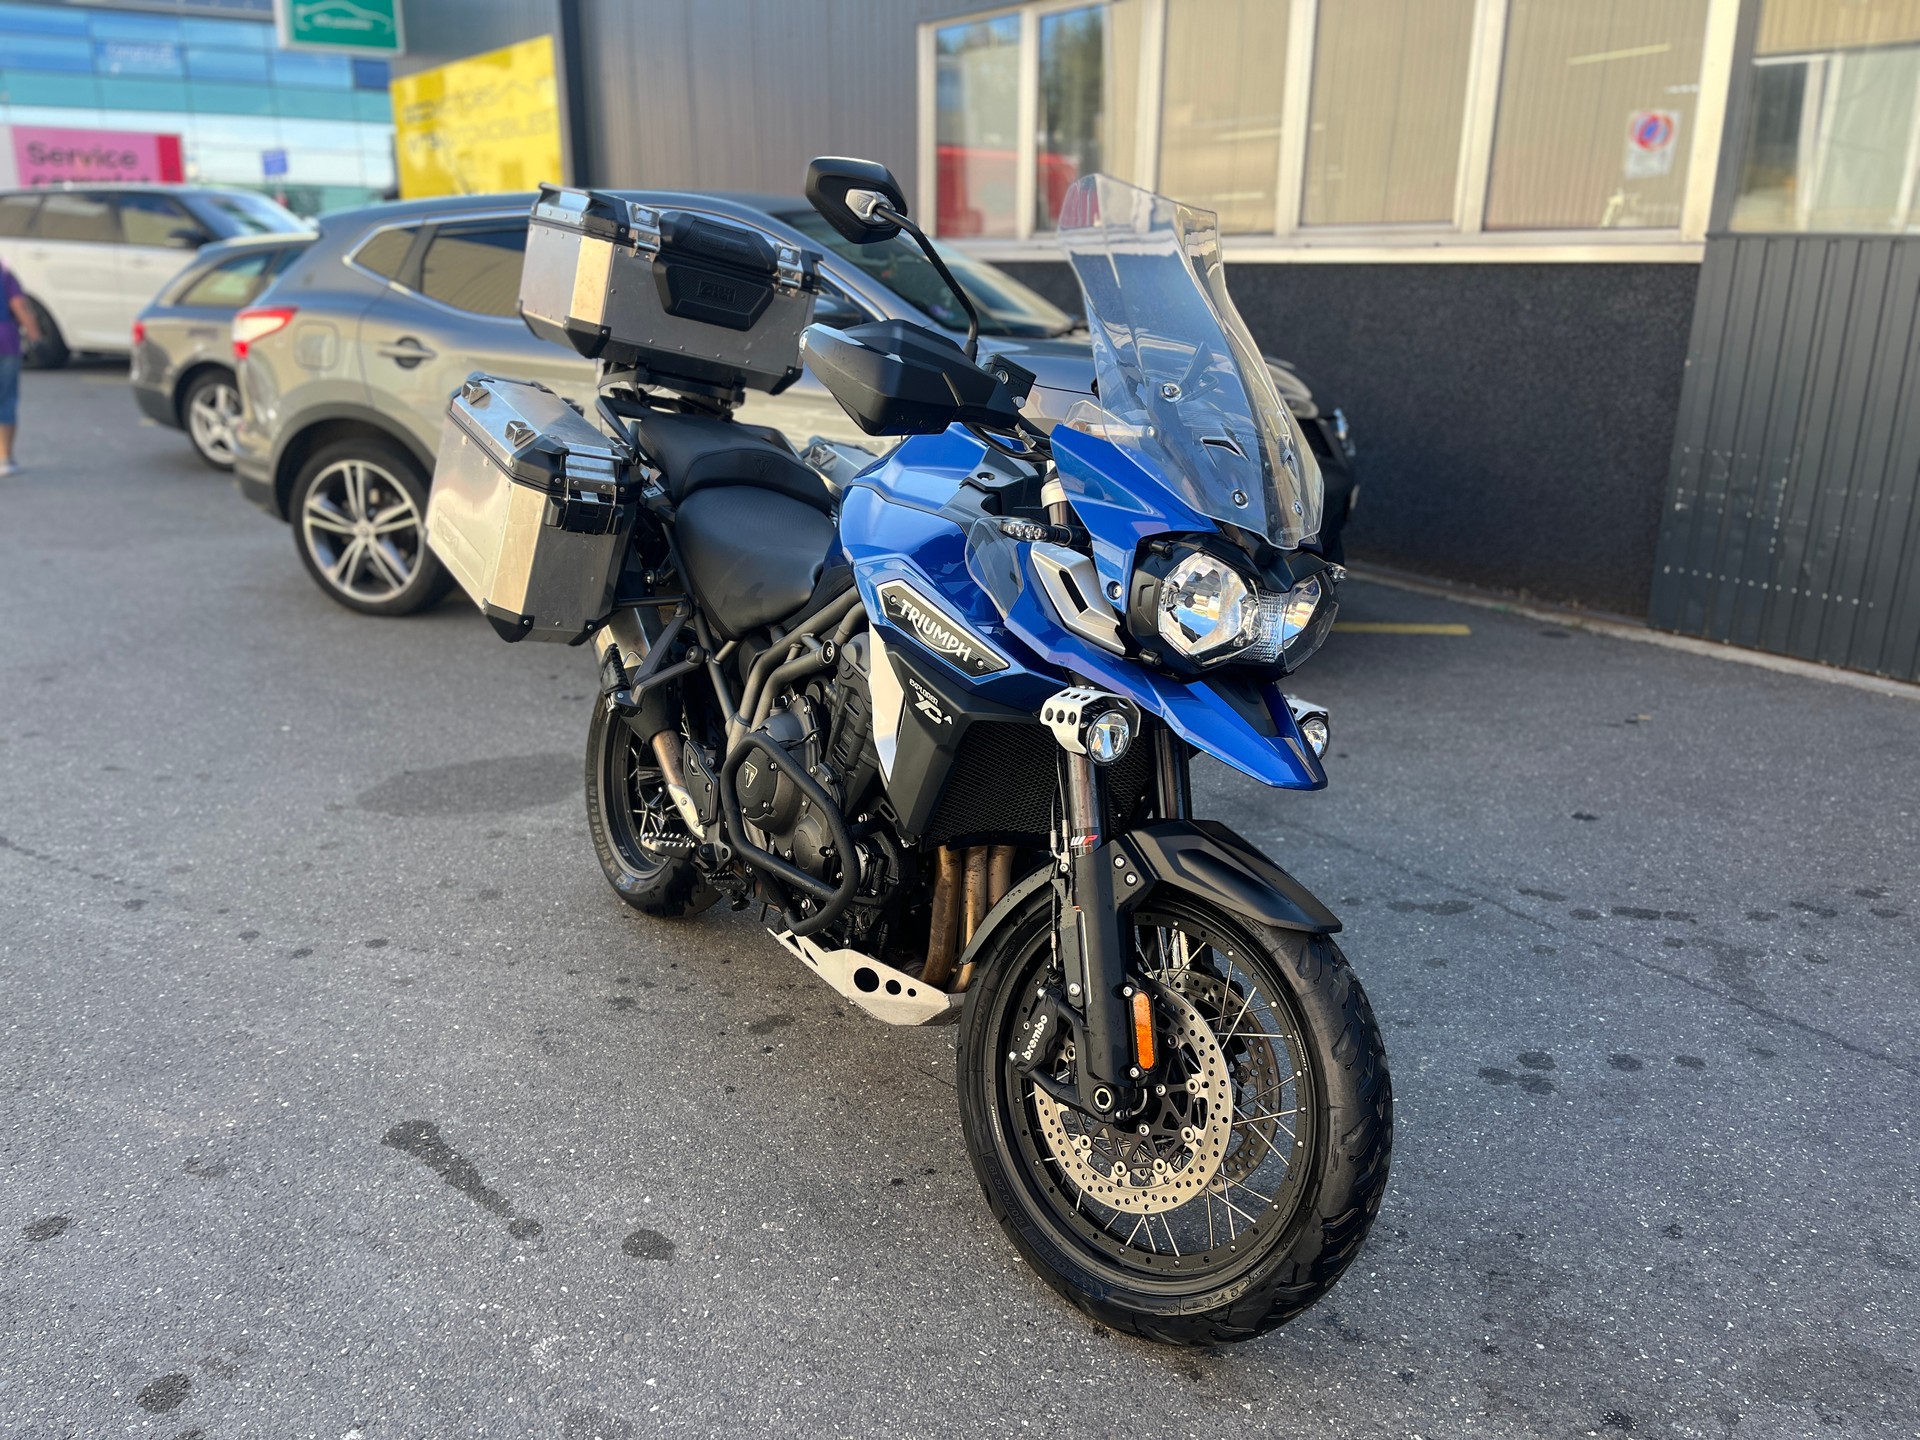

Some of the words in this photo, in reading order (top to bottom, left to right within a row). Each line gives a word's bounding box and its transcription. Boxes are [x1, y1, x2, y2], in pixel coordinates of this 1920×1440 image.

[27, 140, 138, 169] Service
[900, 598, 972, 662] TRIUMPH
[909, 678, 939, 706] EXPLORER
[588, 785, 611, 861] MICHELIN
[1070, 834, 1099, 846] WP
[1021, 1013, 1048, 1061] brembo
[1002, 1194, 1026, 1226] 120/70
